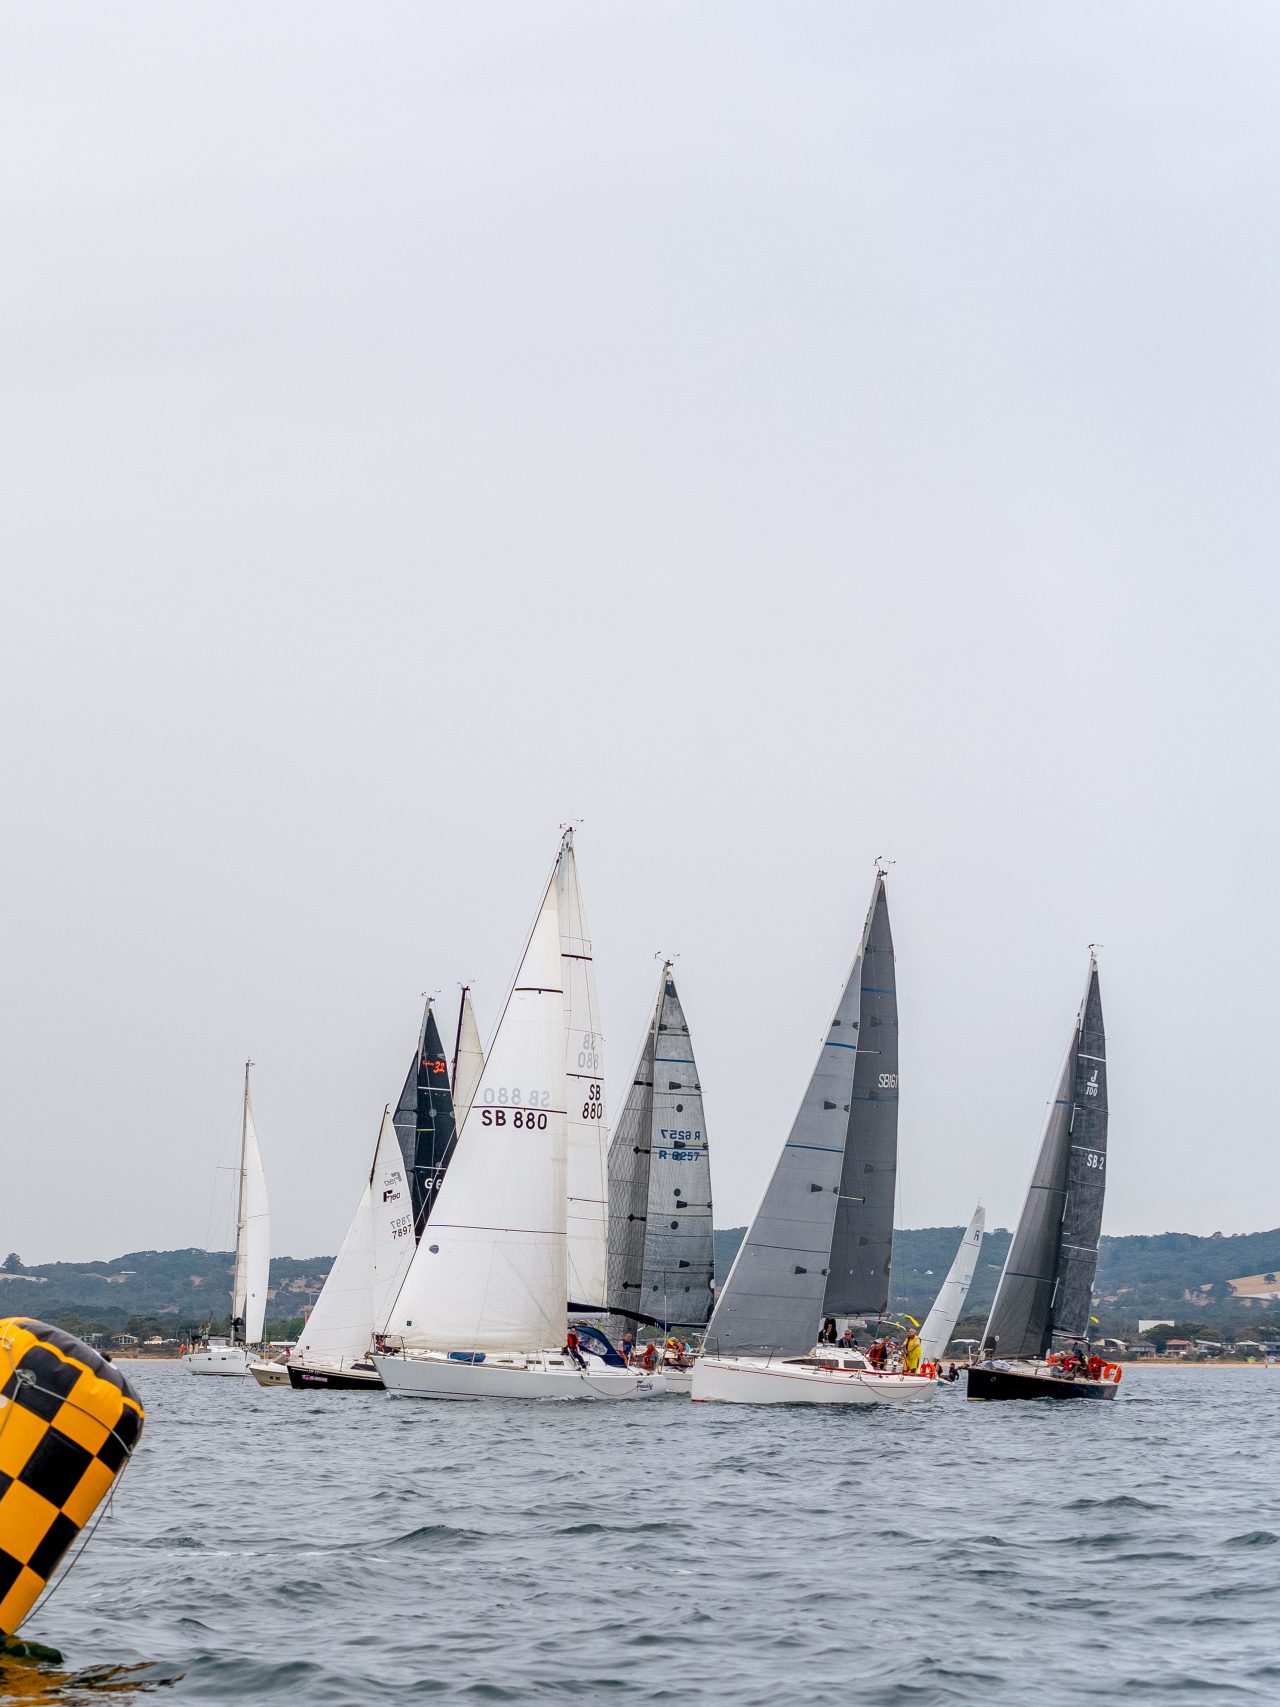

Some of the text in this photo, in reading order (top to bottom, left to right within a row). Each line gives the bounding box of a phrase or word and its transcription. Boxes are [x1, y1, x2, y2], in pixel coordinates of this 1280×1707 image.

[432, 1060, 445, 1073] 32
[1090, 1070, 1098, 1083] J
[588, 1084, 601, 1101] SB
[1086, 1086, 1098, 1097] 100
[582, 1102, 602, 1119] 880
[482, 1109, 548, 1130] SB 880
[659, 1150, 699, 1161] R 6257
[1086, 1153, 1098, 1168] SB
[391, 1224, 412, 1240] 7897
